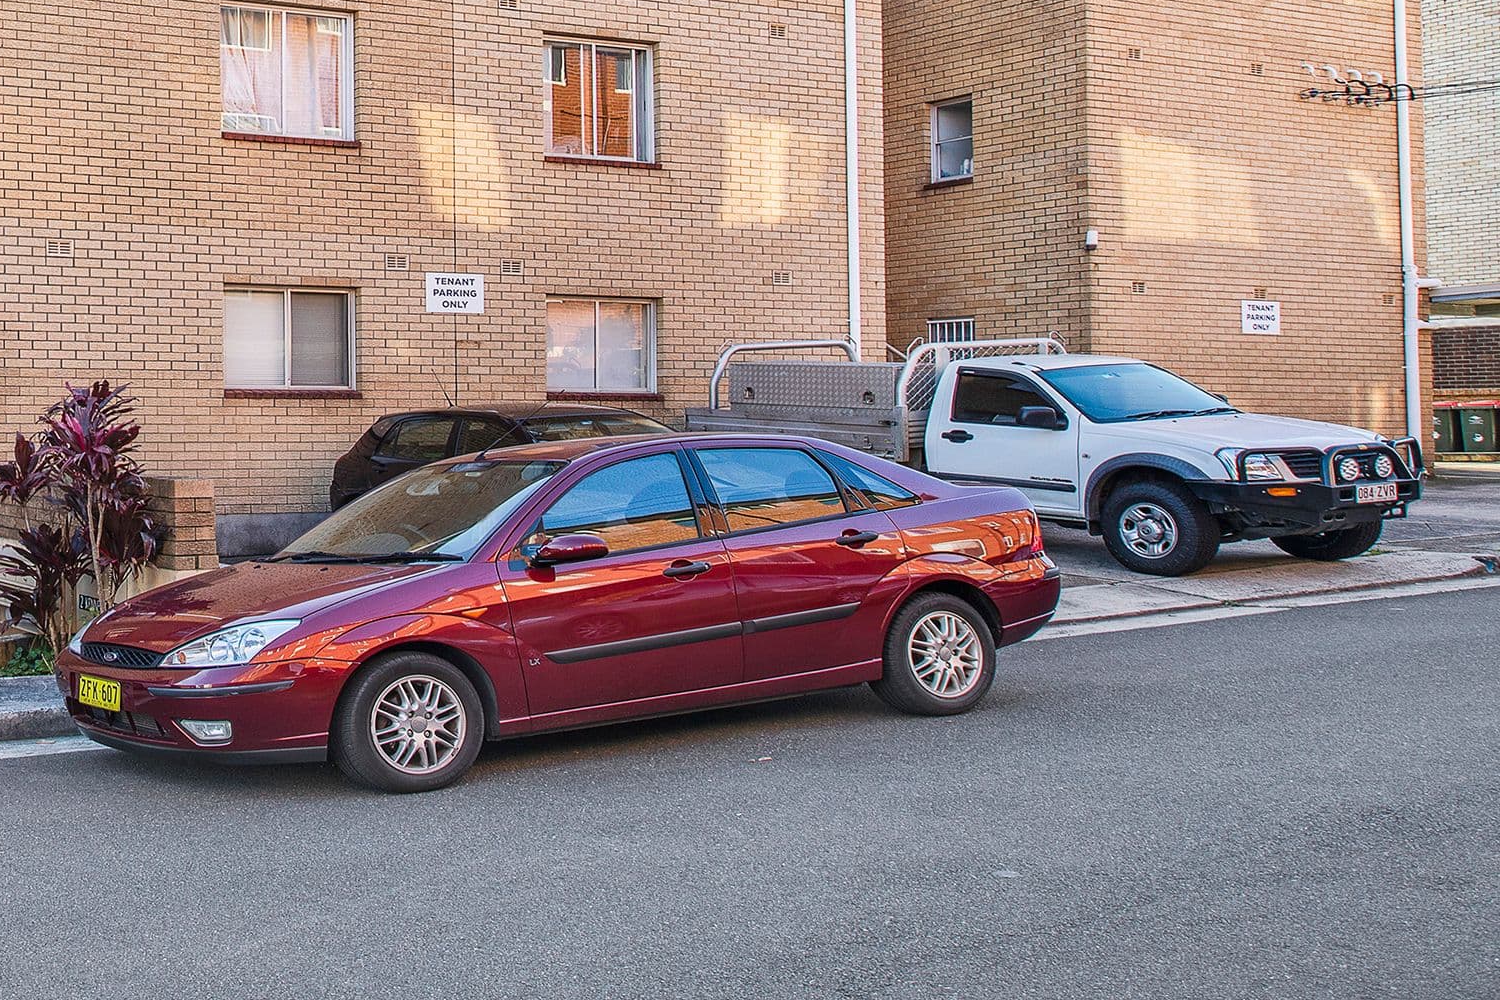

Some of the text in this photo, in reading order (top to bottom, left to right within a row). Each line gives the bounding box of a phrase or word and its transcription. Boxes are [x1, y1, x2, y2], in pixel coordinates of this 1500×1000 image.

[434, 277, 475, 286] TENANT
[433, 288, 477, 298] PARKING
[442, 300, 469, 309] ONLY
[1247, 304, 1275, 312] TENANT
[1246, 313, 1276, 322] PARKING
[1252, 323, 1270, 331] ONLY
[529, 658, 541, 666] LX
